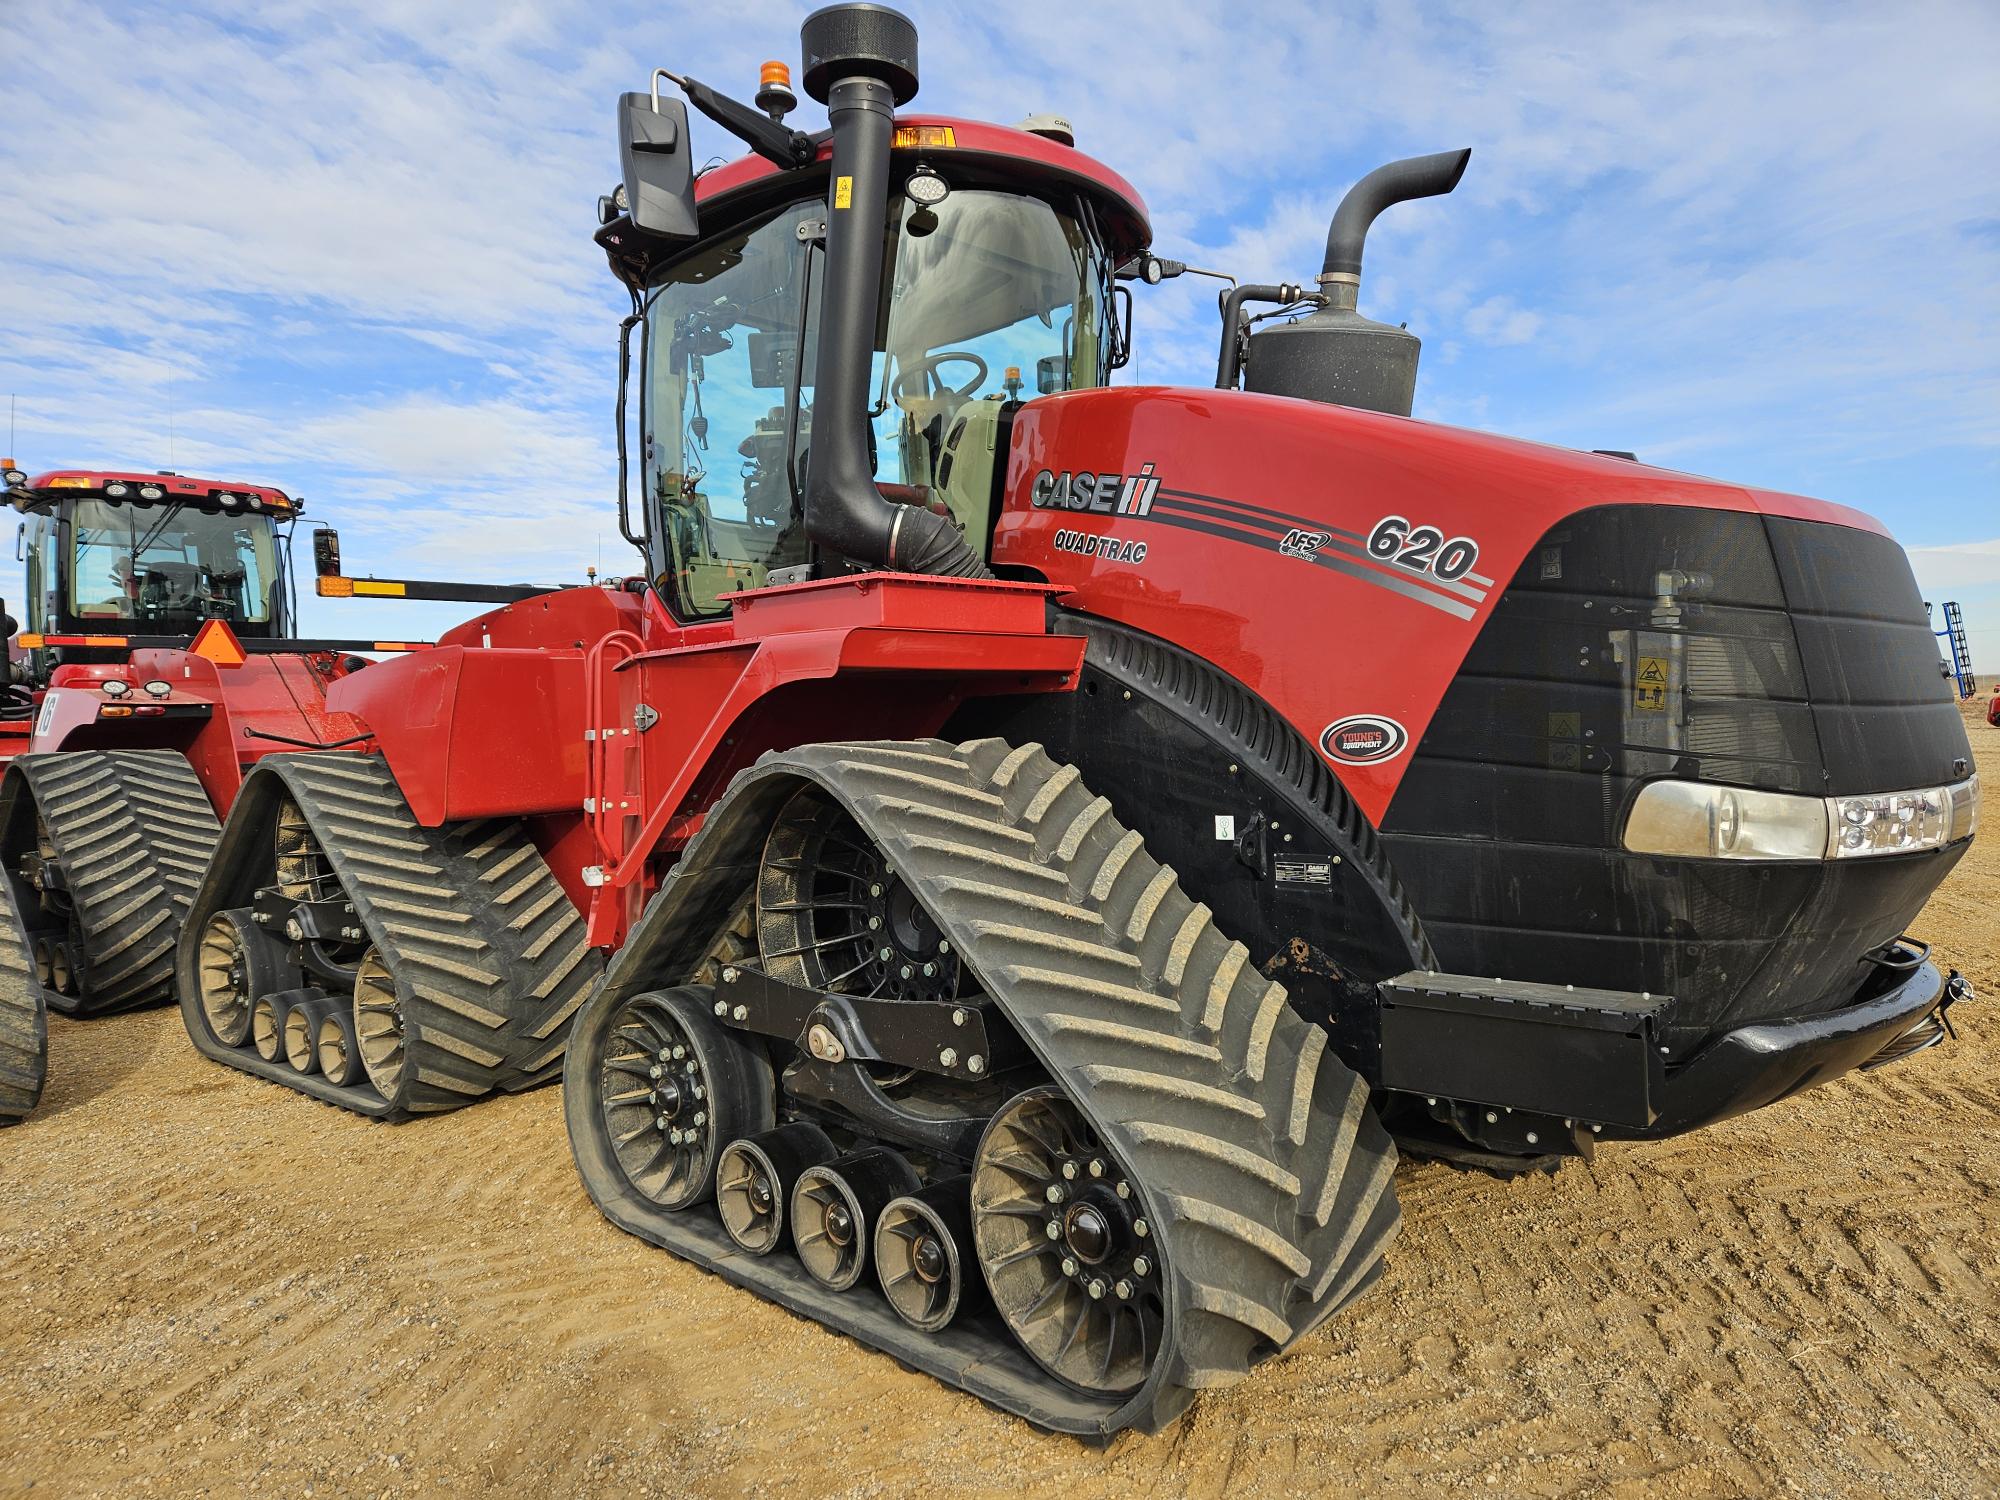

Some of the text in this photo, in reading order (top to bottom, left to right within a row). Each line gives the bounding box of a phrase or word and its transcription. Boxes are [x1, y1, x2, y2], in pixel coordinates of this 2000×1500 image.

[1031, 469, 1122, 513] CASE
[1054, 529, 1147, 564] QUADTRAC
[1280, 529, 1322, 550] AFS
[1367, 515, 1479, 583] 620
[1342, 732, 1382, 743] YOUNG'S
[1342, 741, 1382, 750] EQUIPMENT
